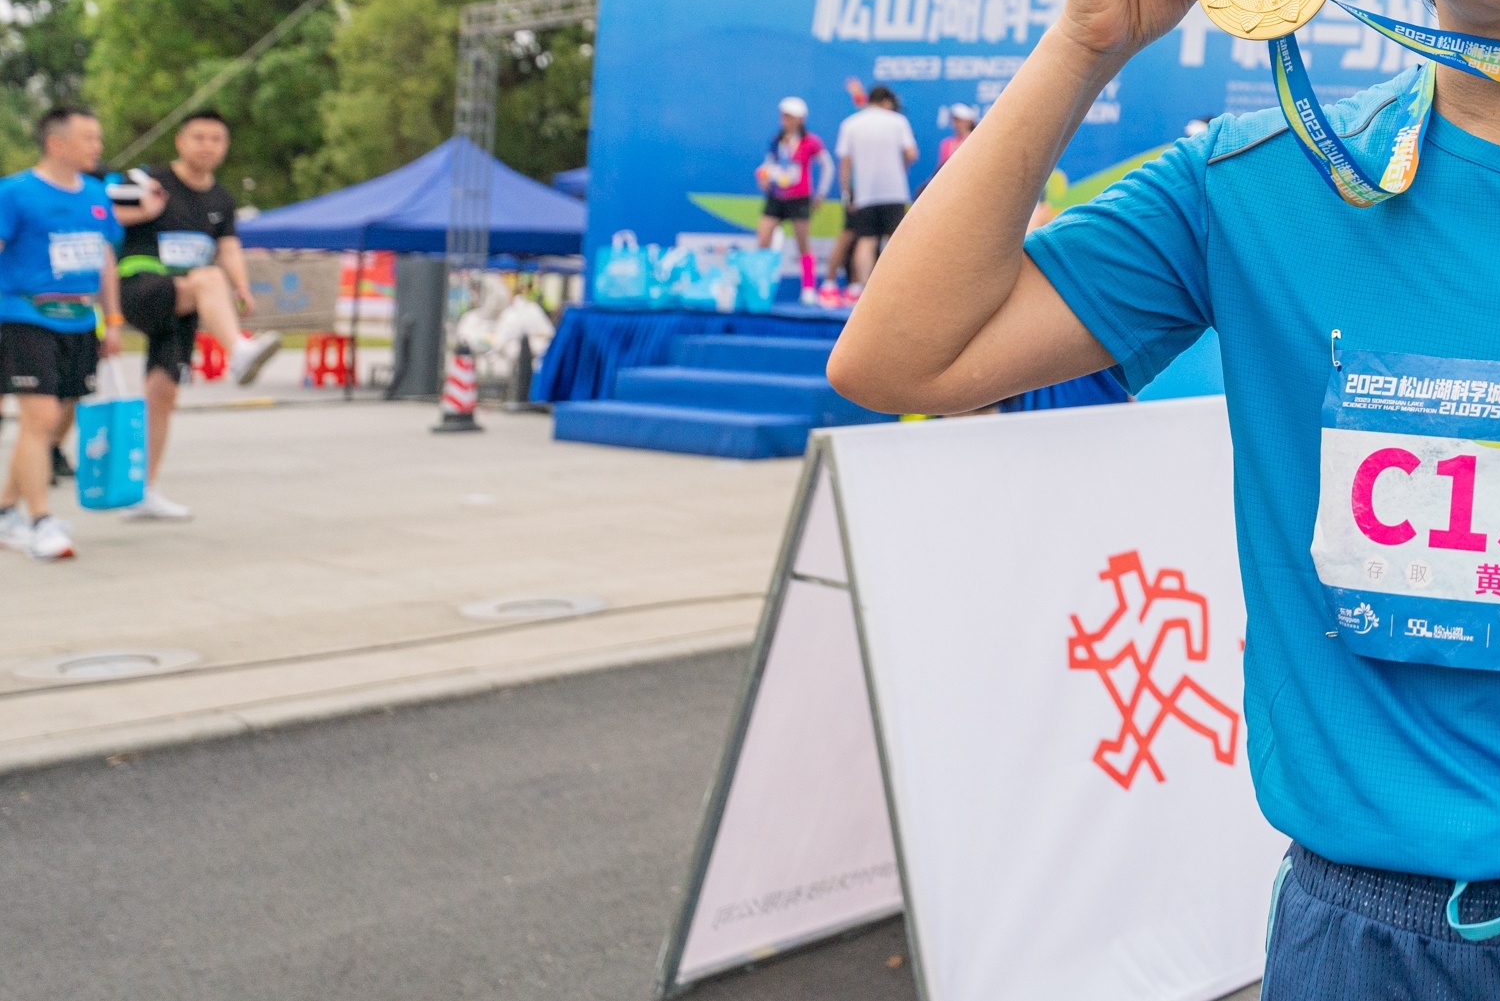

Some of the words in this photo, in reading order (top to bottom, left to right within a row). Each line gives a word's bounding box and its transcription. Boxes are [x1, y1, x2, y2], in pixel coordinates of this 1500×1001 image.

[1394, 24, 1436, 47] 2023
[1280, 36, 1293, 73] 动时代
[1296, 98, 1327, 141] 2023
[1345, 373, 1398, 396] 2023
[1342, 401, 1367, 409] SCIENCE
[1400, 406, 1437, 414] MARATHON
[1371, 398, 1407, 406] SONGSHAN
[1367, 561, 1384, 580] 存
[1409, 564, 1427, 582] 取
